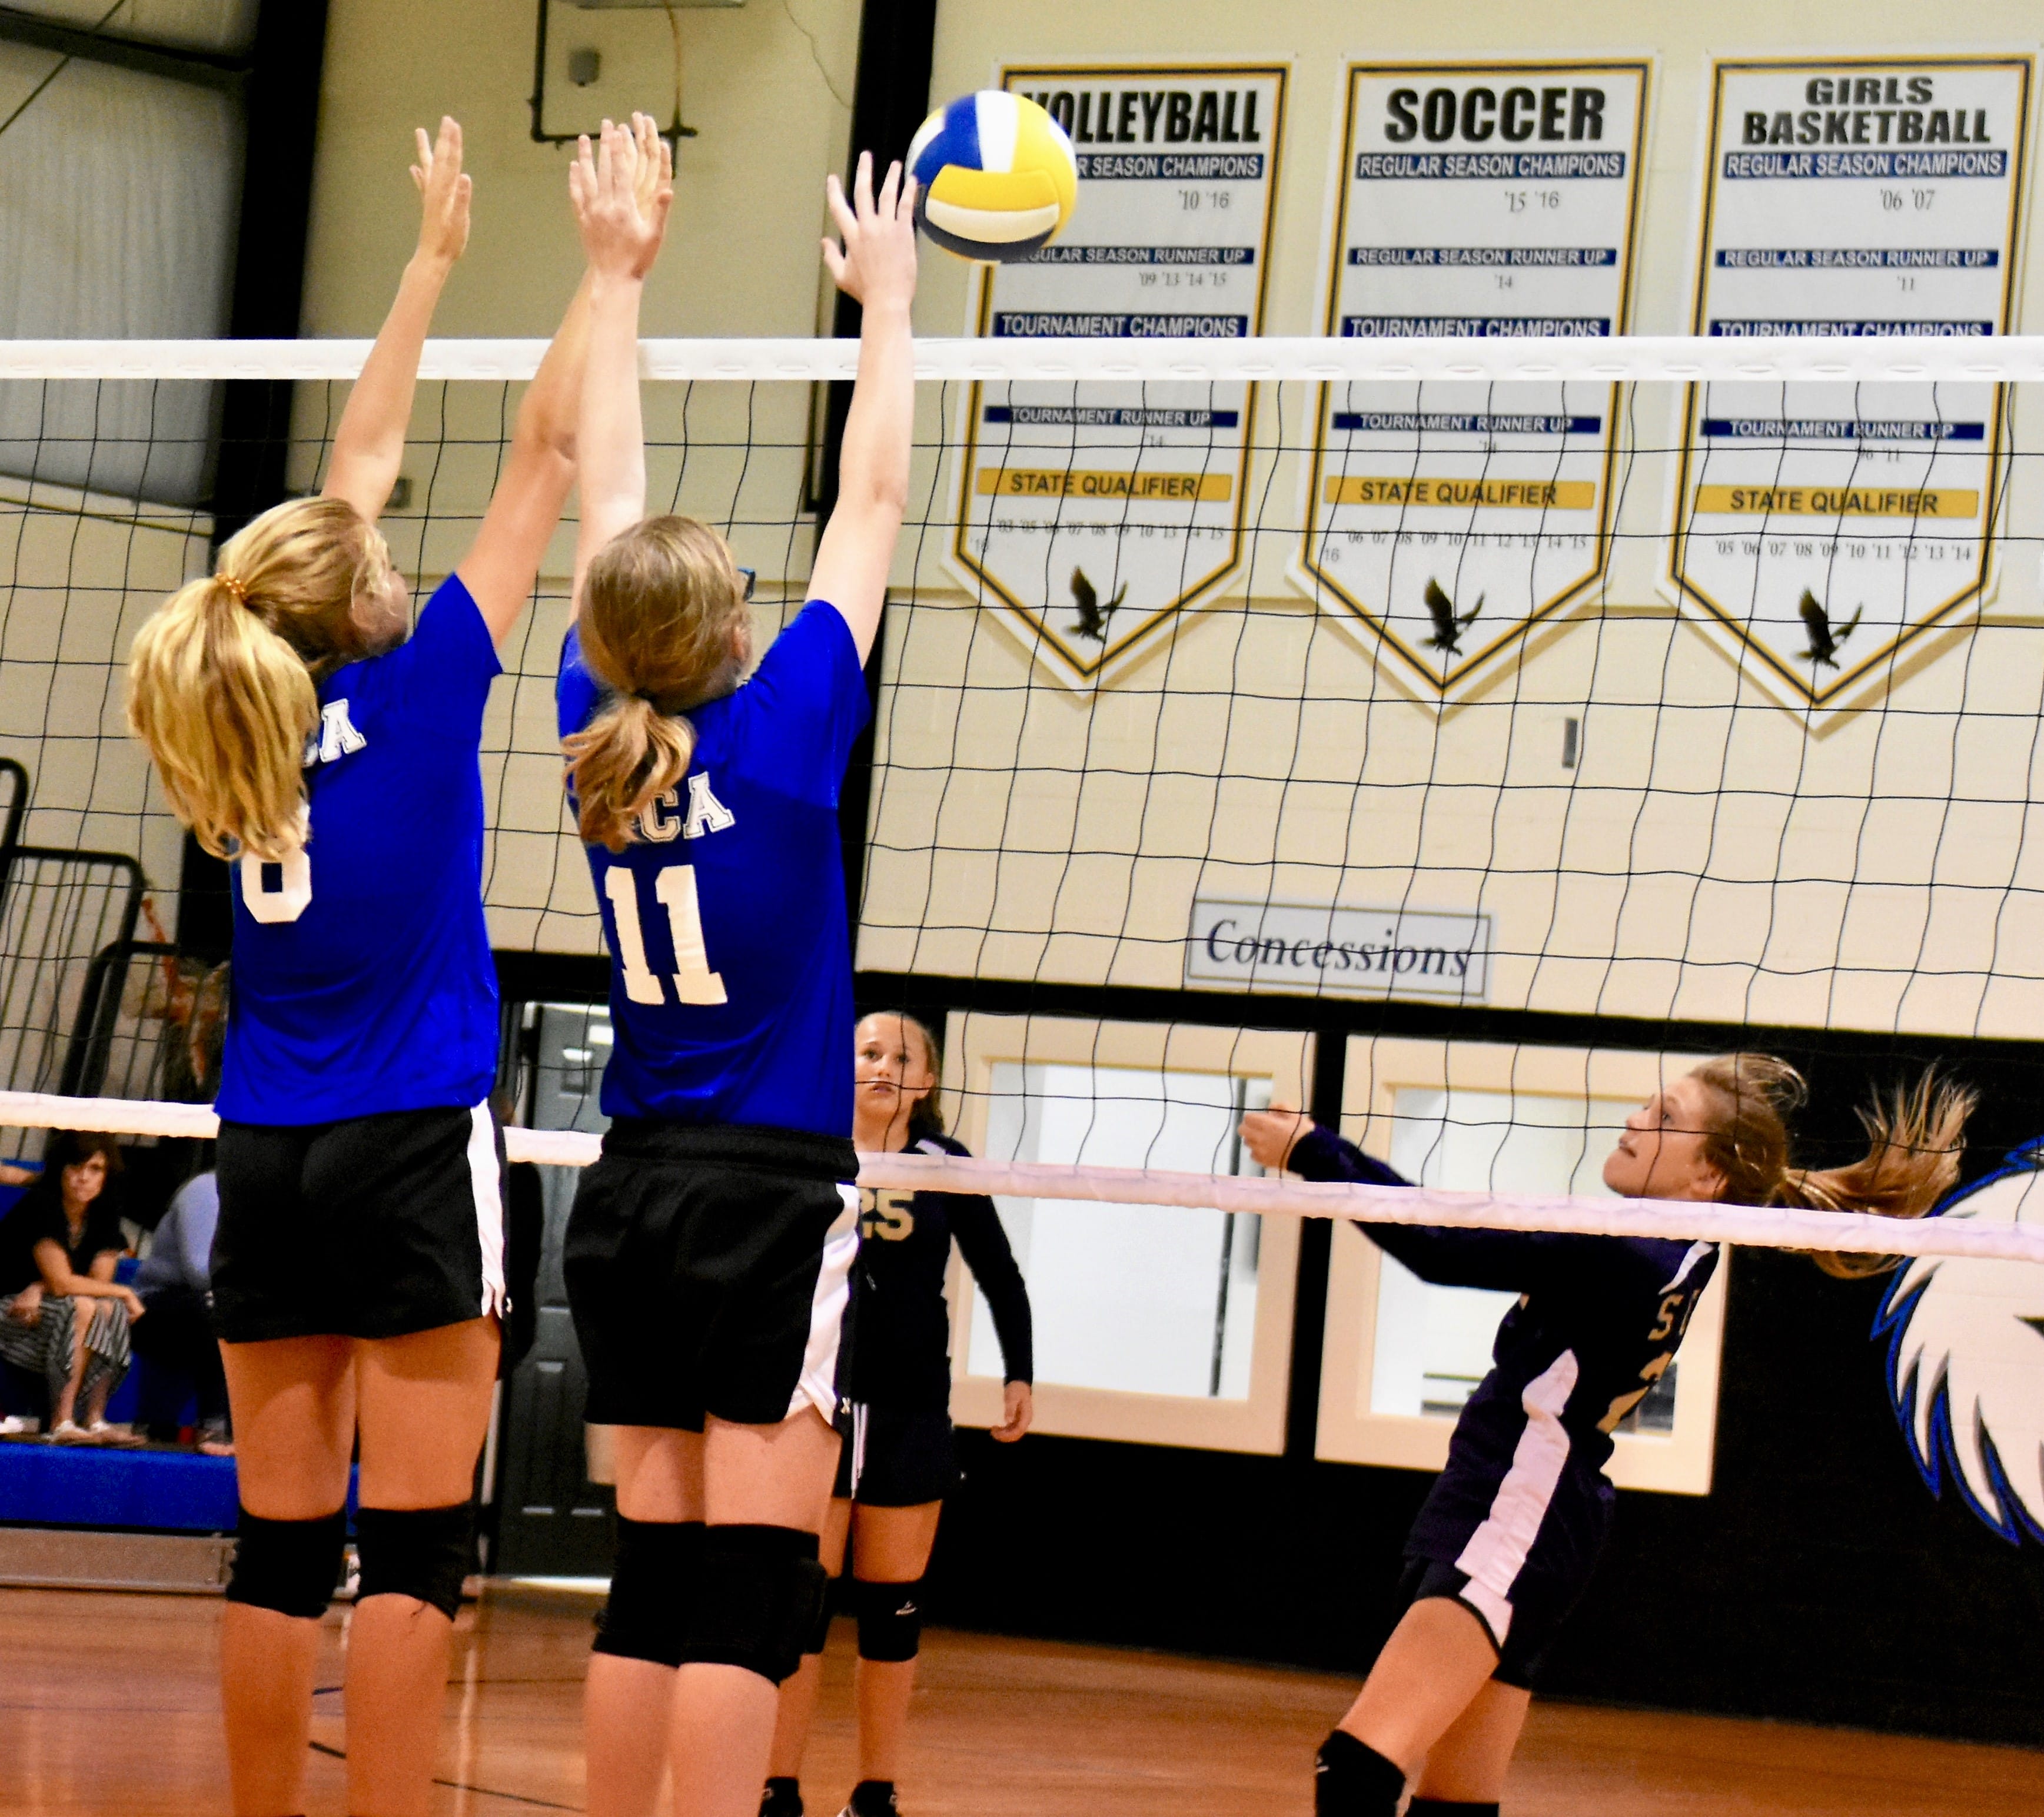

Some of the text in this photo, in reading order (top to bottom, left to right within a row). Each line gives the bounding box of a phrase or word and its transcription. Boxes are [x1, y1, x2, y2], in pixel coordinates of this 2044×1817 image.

[1804, 77, 1933, 105] GIRLS
[1384, 87, 1606, 142] SOCCER
[1742, 108, 1990, 145] BASKETBALL
[1092, 156, 1157, 177] SEASON
[1162, 156, 1259, 177] CHAMPIONS
[1359, 155, 1620, 176] REGULAR SEASON CHAMPIONS
[1727, 153, 2000, 176] REGULAR SEASON CHAMPIONS
[1178, 190, 1229, 210] '10 '16
[1504, 191, 1559, 213] '15 '16
[1880, 188, 1935, 210] '06 '07
[1086, 248, 1149, 263] SEASON
[1154, 249, 1219, 263] RUNNER
[1224, 250, 1245, 263] UP
[1357, 250, 1606, 264] REGULAR SEASON RUNNER UP
[1725, 251, 1988, 267] REGULAR SEASON RUNNER UP
[1001, 315, 1238, 337] TOURNAMENT CHAMPIONS
[1351, 319, 1600, 337] TOURNAMENT CHAMPIONS
[1719, 323, 1982, 336] TOURNAMENT CHAMPIONS
[1012, 408, 1211, 426] TOURNAMENT RUNNER UP
[1360, 414, 1573, 431] TOURNAMENT RUNNER UP
[1730, 421, 1954, 438] TOURNAMENT RUNNER UP
[1011, 474, 1197, 496] STATE QUALIFIER
[1361, 481, 1557, 504] STATE QUALIFIER
[1731, 490, 1938, 514] STATE QUALIFIER
[604, 865, 728, 1005] 11
[1207, 919, 1470, 977] Concessions
